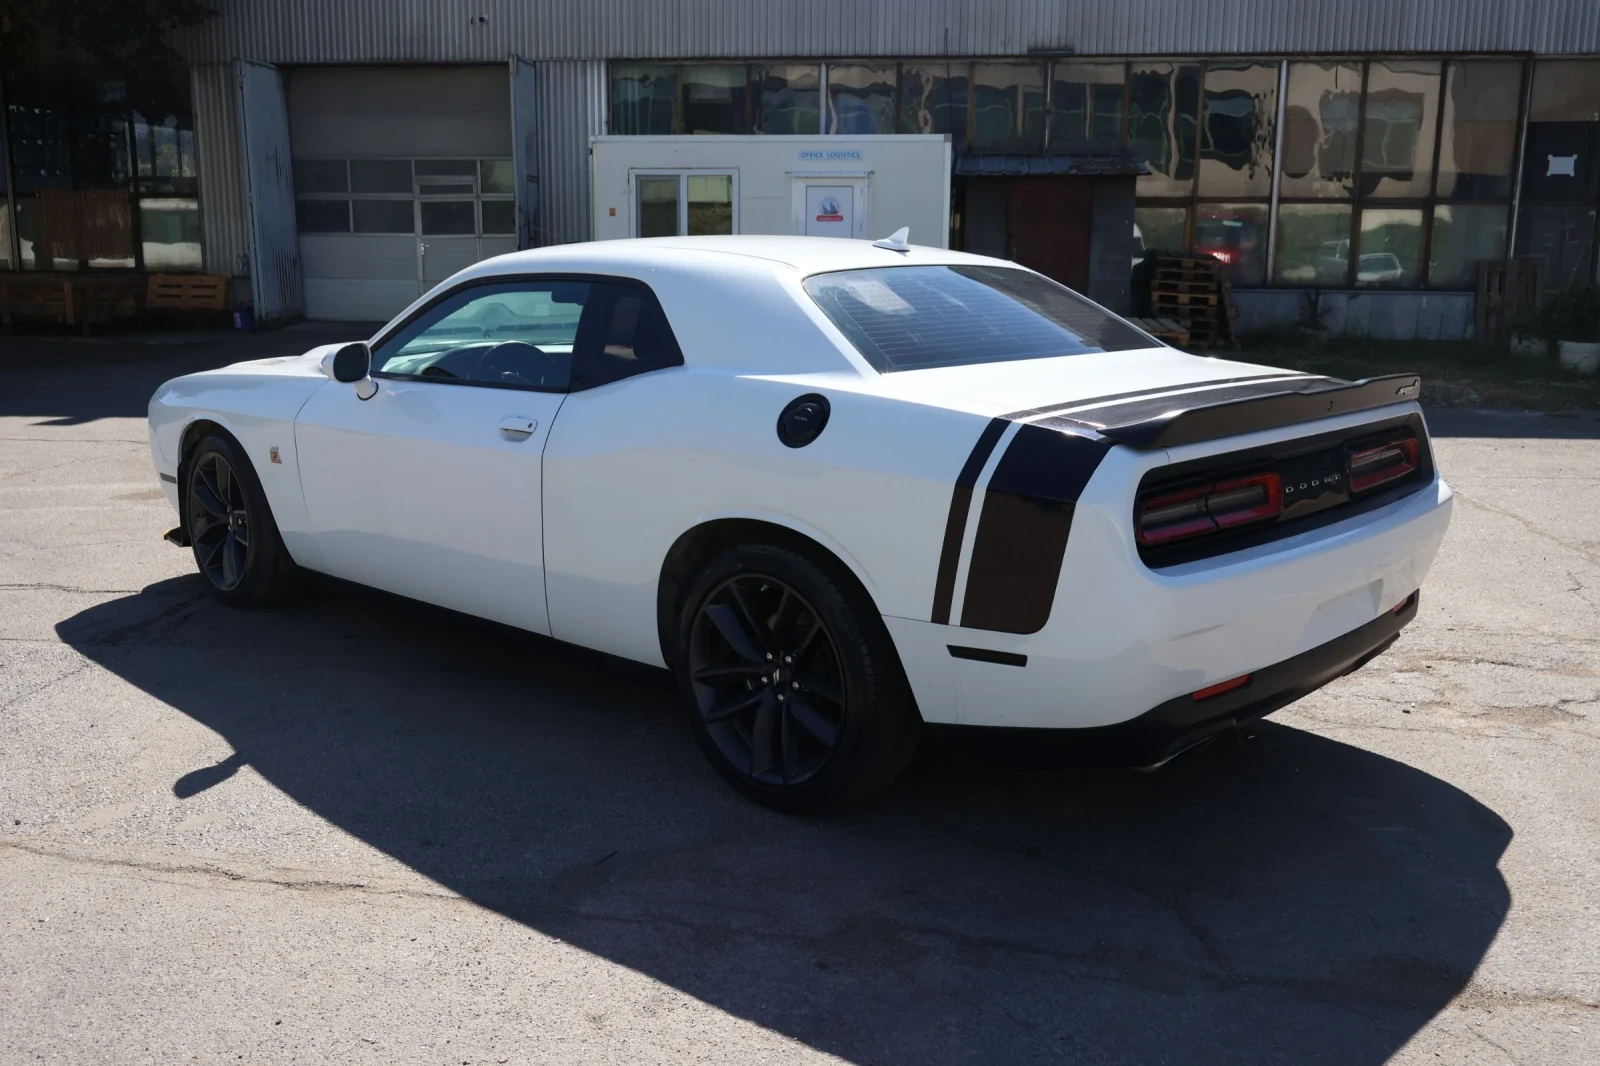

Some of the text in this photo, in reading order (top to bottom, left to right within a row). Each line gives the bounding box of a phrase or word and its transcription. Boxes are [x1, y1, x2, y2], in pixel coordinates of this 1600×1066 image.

[800, 151, 861, 159] OFFICE LOGISTICS
[1285, 473, 1341, 493] DODGE
